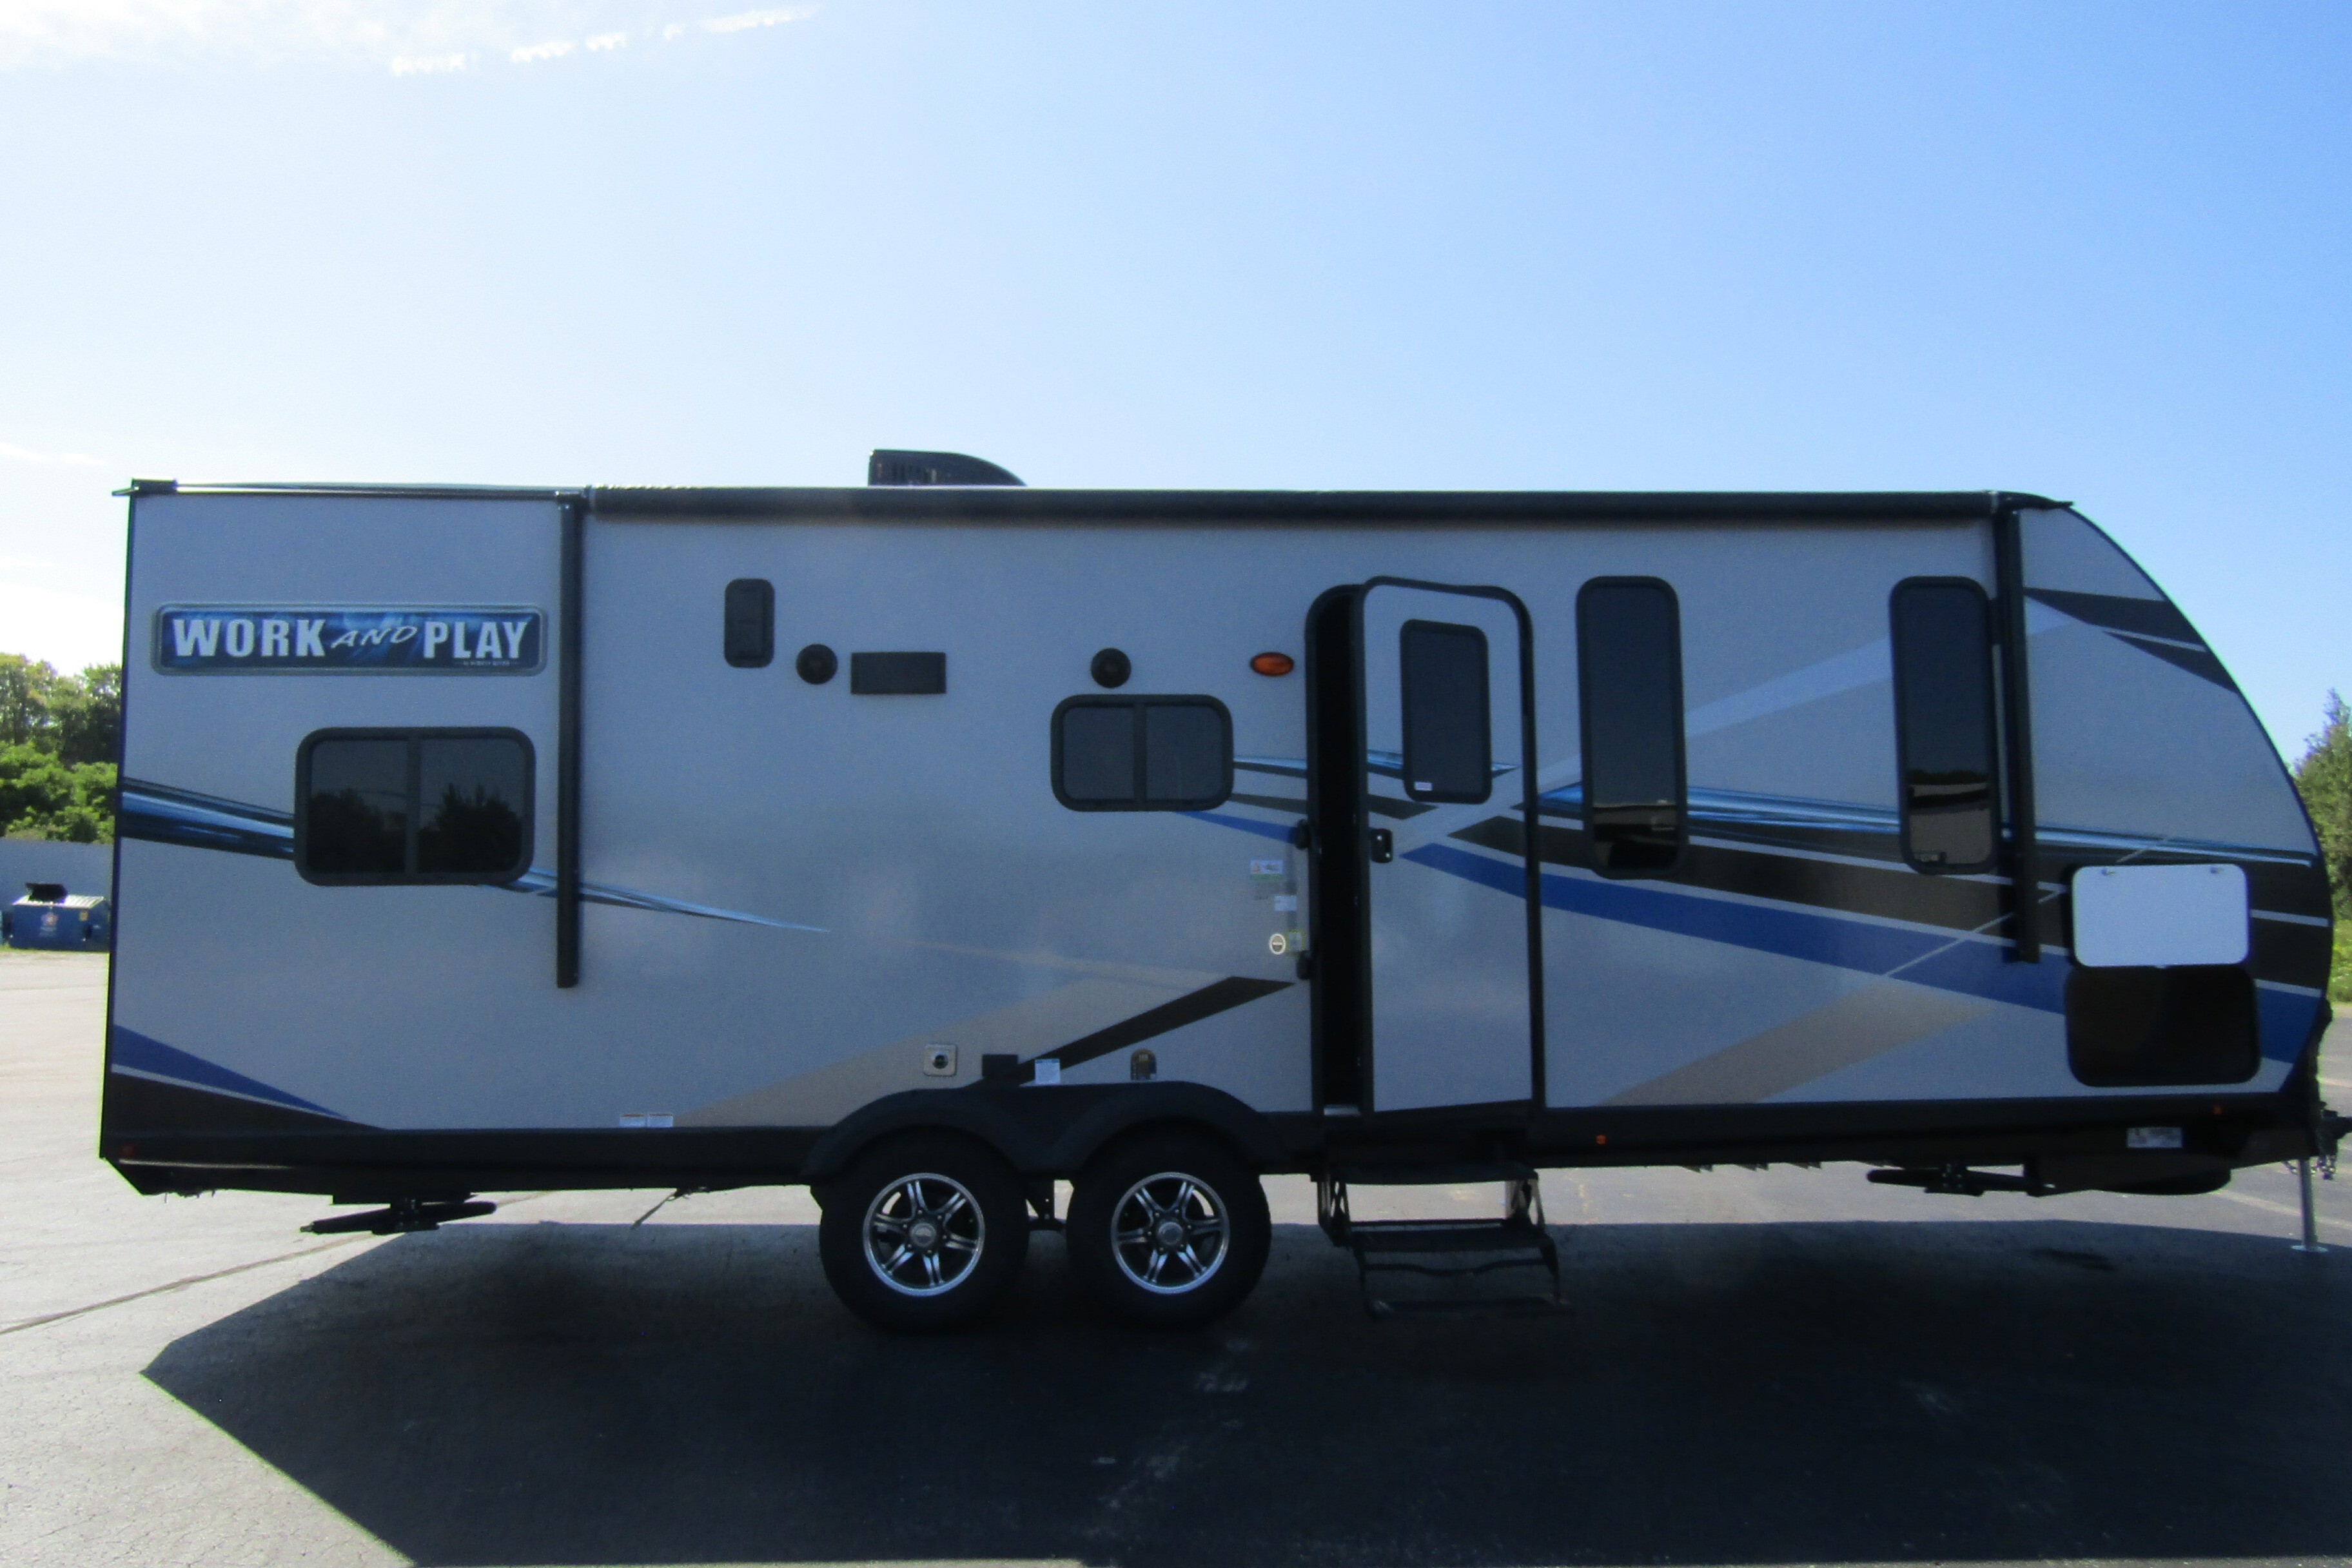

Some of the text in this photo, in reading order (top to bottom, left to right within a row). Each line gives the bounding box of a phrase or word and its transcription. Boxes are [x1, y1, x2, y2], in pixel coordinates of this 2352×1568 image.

[172, 618, 528, 659] WORK AND PLAY
